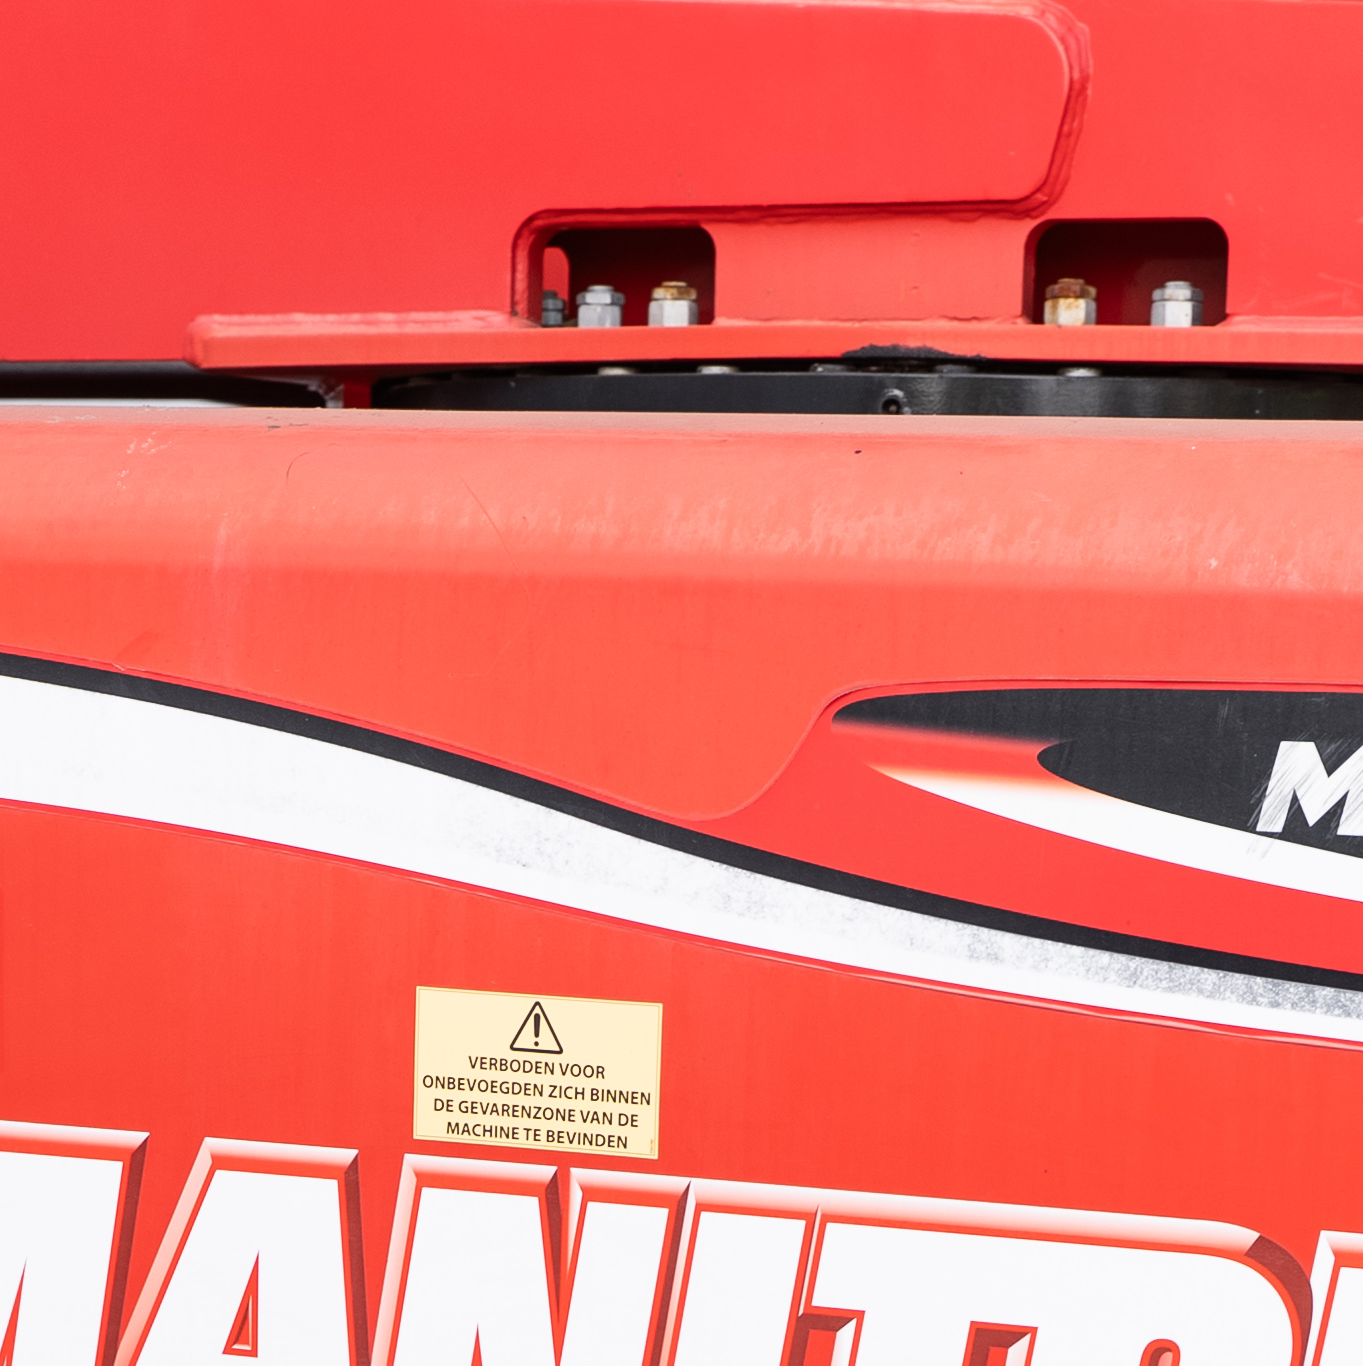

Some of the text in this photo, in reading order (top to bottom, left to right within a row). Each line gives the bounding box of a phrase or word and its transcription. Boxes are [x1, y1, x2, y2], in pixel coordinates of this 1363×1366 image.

[468, 1055, 605, 1080] VERBODEN VOOR
[422, 1074, 651, 1106] ONBEVOEGDEN ZICH BINNEN
[433, 1098, 639, 1128] DE GEVARENZONE VAN DE
[446, 1121, 520, 1140] MACHINE
[522, 1127, 542, 1142] TE
[546, 1129, 628, 1150] BEVINDEN
